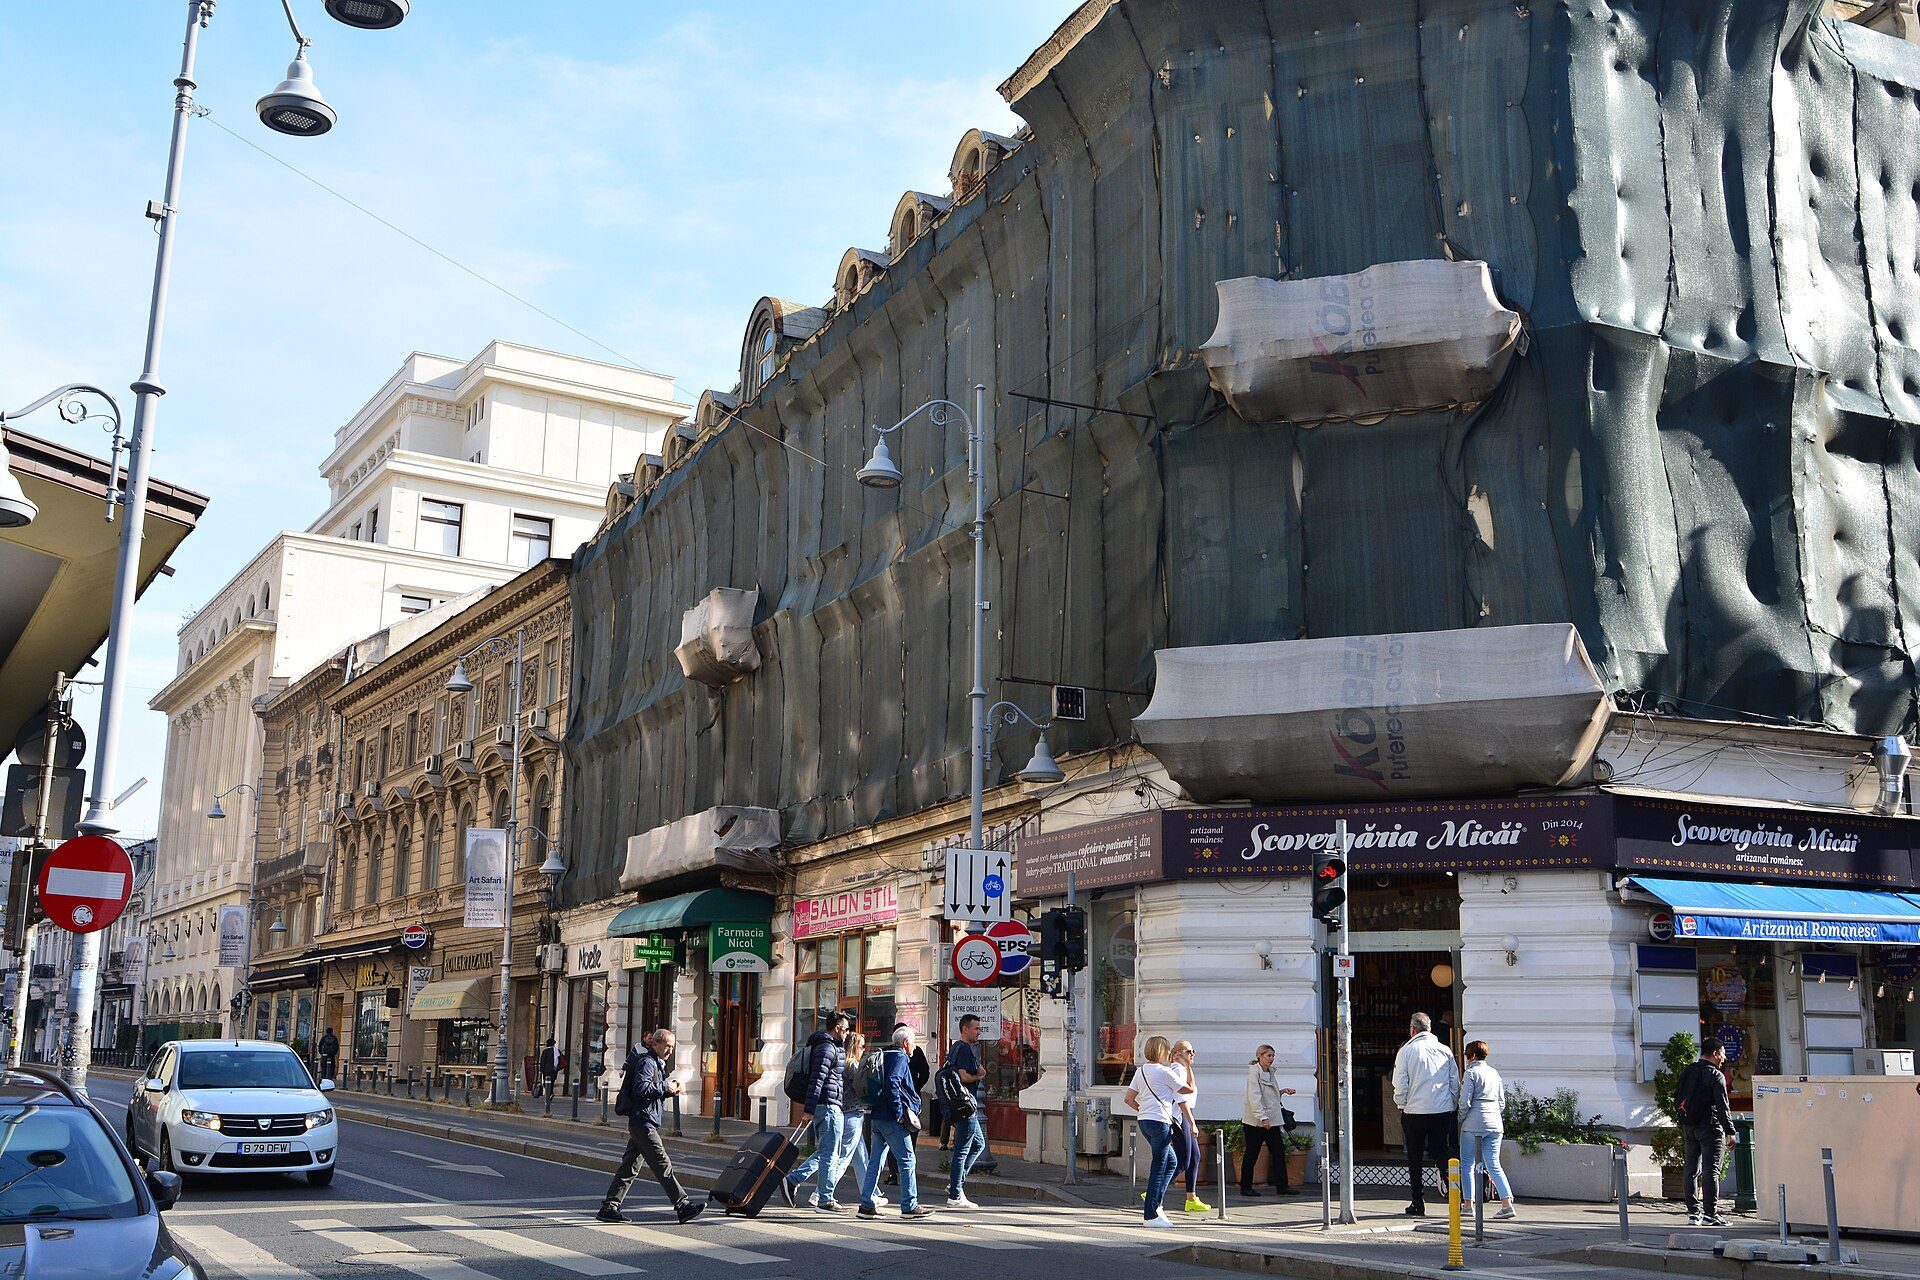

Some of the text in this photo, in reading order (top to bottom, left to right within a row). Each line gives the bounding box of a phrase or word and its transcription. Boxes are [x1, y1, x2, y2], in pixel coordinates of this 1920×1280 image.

[1385, 701, 1411, 780] Puterea
[1190, 826, 1224, 834] artizanal
[1542, 819, 1583, 831] Din 2014
[1426, 819, 1523, 850] Micăi
[1671, 813, 1858, 852] Scovergăria Micăi
[1139, 833, 1151, 848] din
[1189, 835, 1224, 844] românesc
[1139, 850, 1151, 858] 2014
[1735, 852, 1803, 866] artizanal românesc
[469, 876, 502, 884] Art Safari
[810, 892, 859, 922] SALON
[862, 884, 897, 912] STIL
[718, 927, 764, 938] Farmacia
[1742, 920, 1878, 938] Artizanal Romanesc
[728, 938, 754, 948] Nicol
[578, 944, 602, 971] Noelle
[243, 1144, 288, 1153] B 79 DFW
